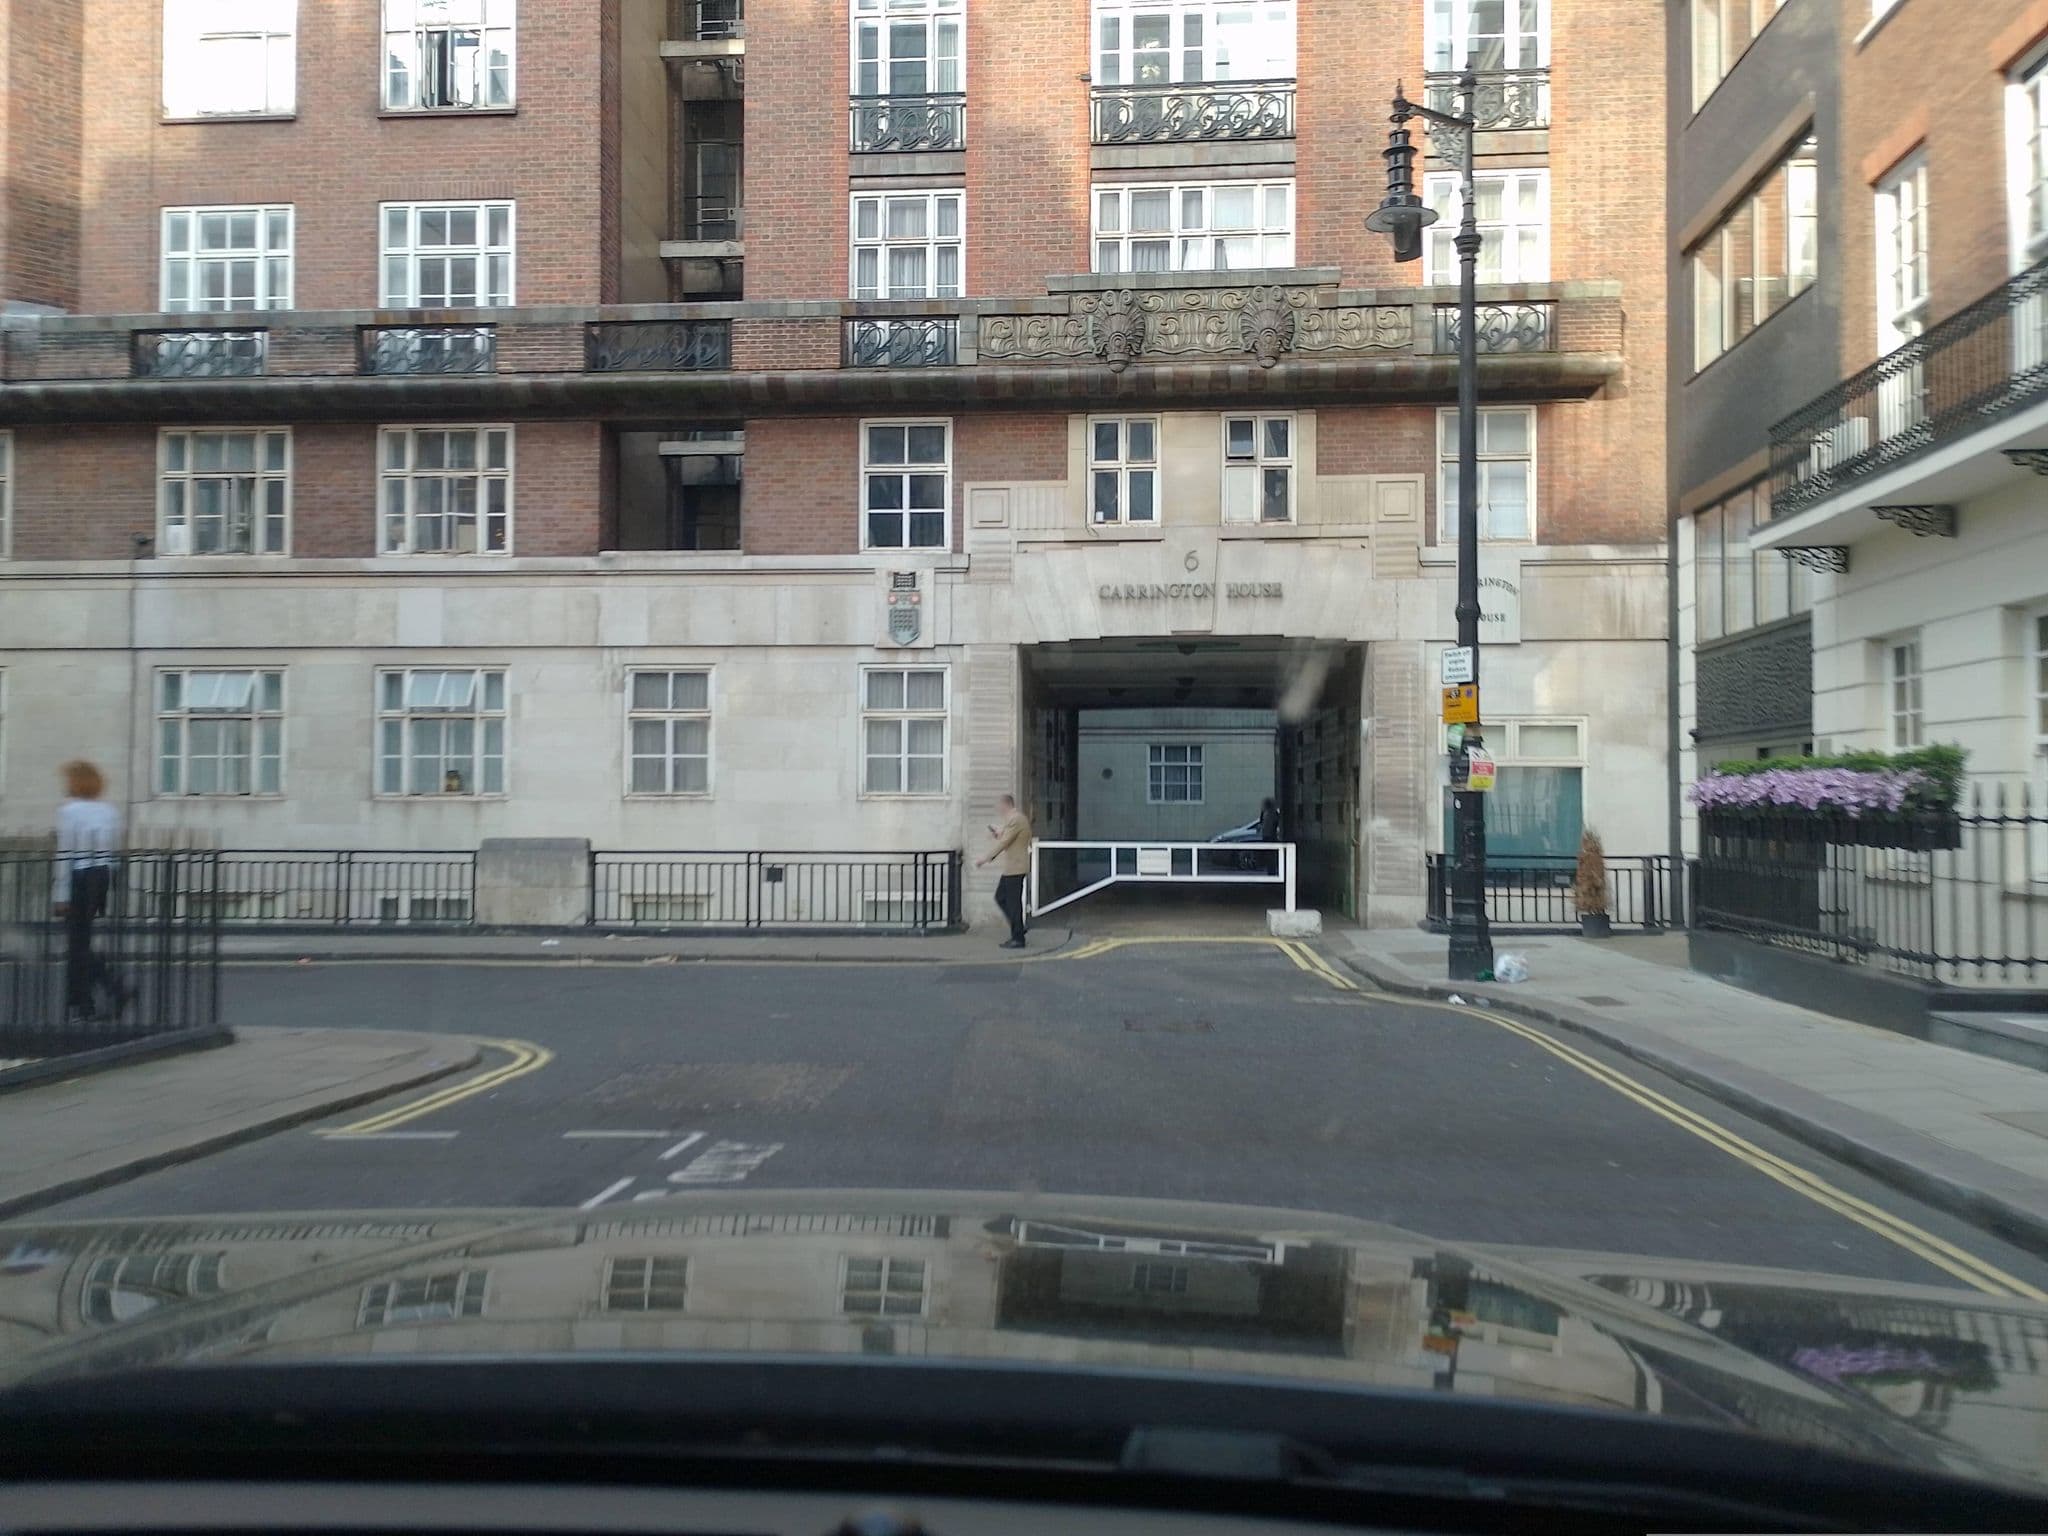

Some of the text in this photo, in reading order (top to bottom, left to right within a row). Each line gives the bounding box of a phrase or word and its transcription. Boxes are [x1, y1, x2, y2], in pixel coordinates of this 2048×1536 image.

[1184, 550, 1200, 572] 6
[1099, 582, 1283, 600] CARRINGTON HOUSE
[1479, 613, 1505, 622] OUSE
